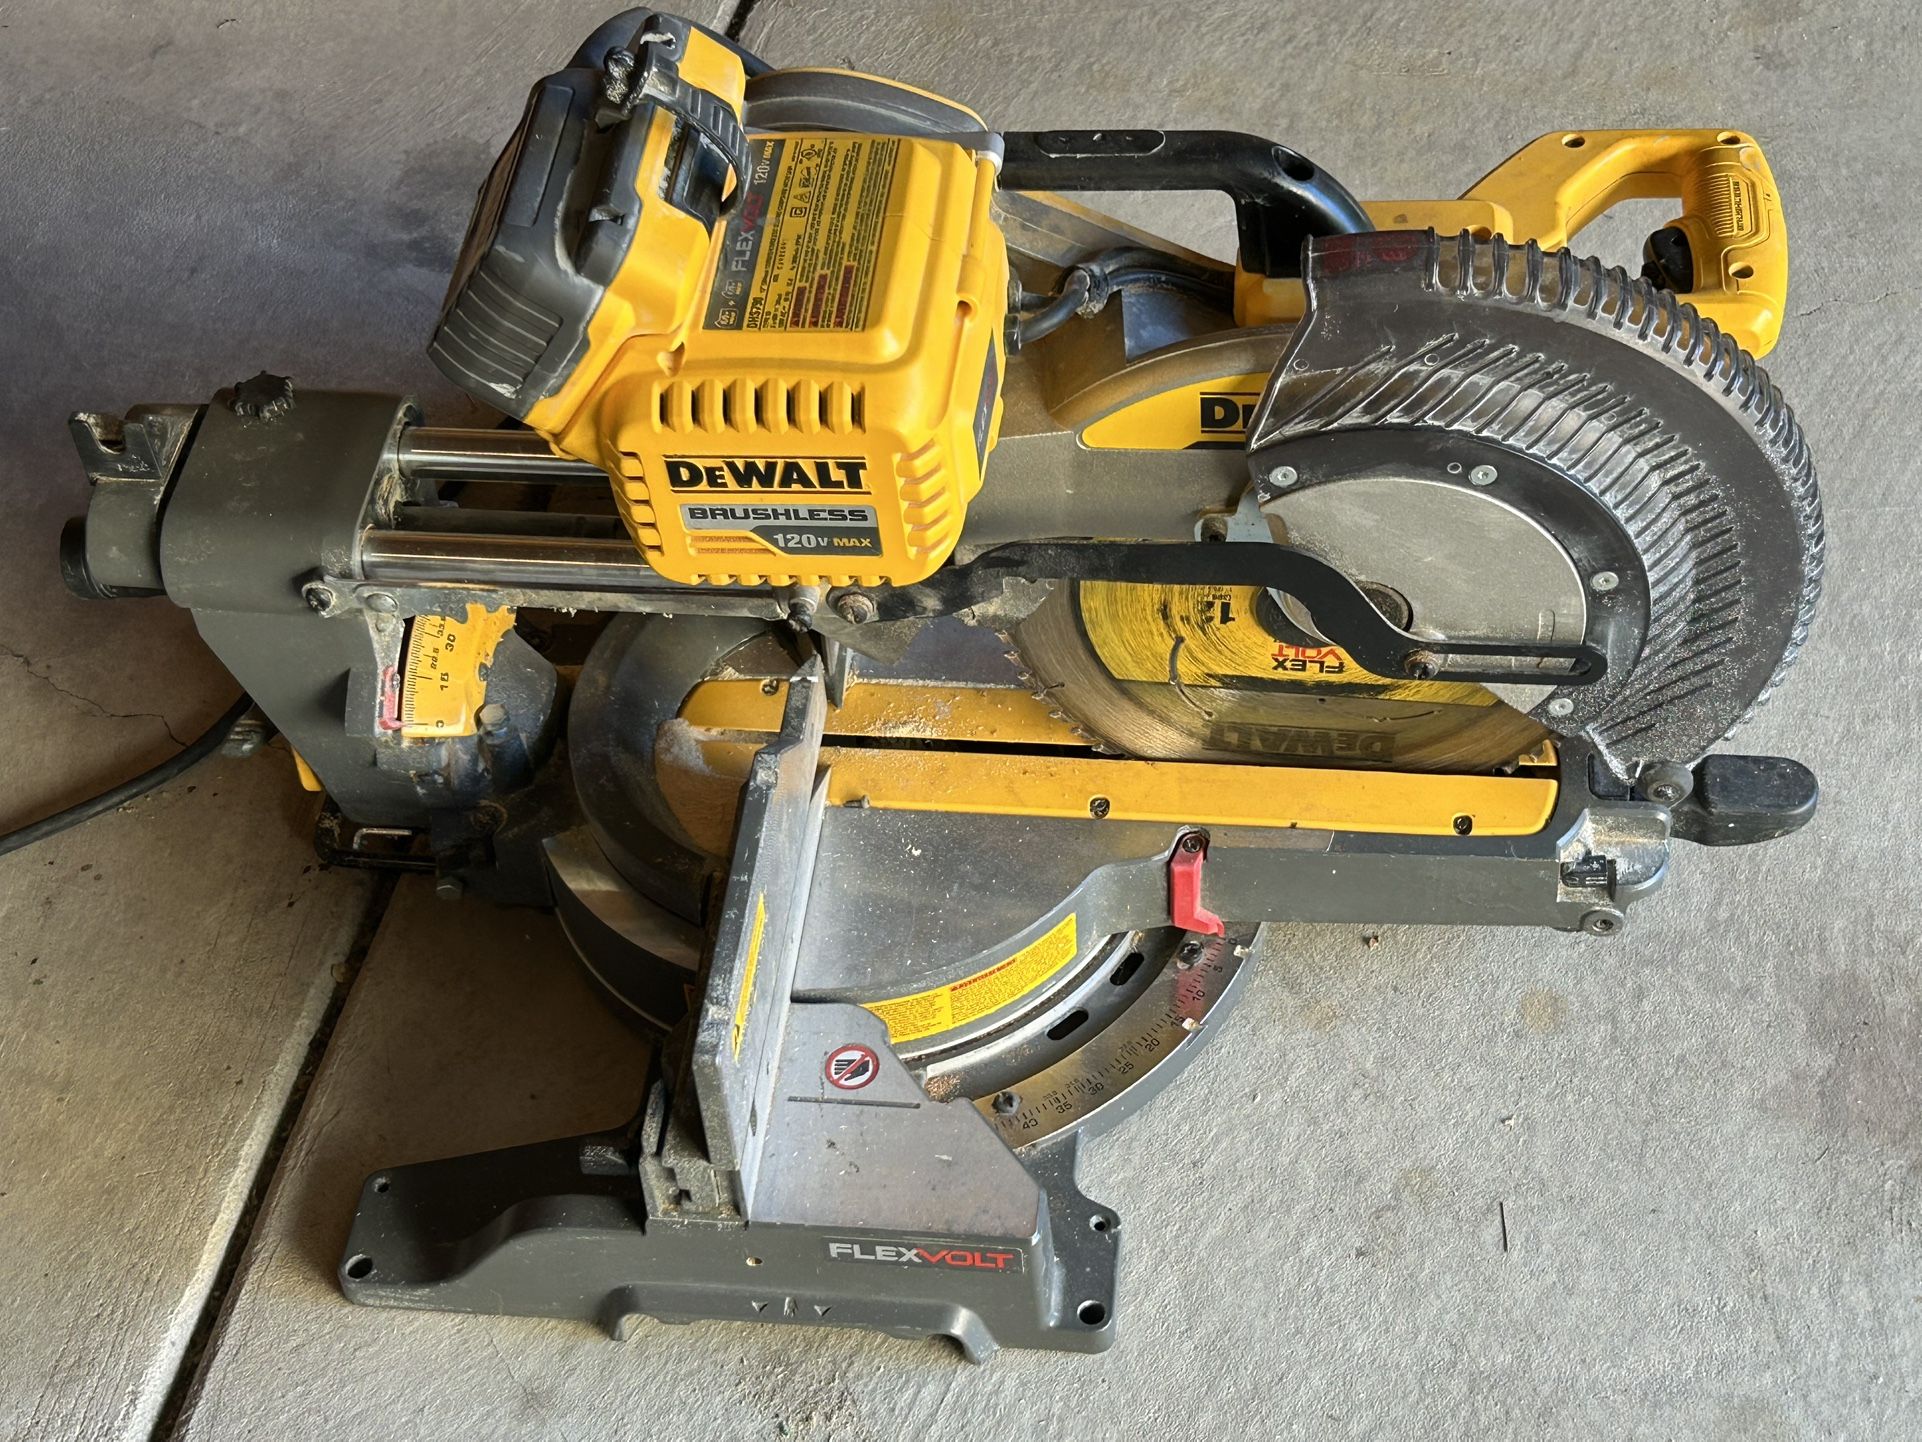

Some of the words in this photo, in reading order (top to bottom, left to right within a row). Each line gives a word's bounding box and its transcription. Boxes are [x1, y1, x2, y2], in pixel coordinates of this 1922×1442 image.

[664, 460, 868, 490] DEWALT
[688, 507, 869, 522] BRUSHLESS
[773, 533, 828, 549] 120V
[833, 537, 872, 549] MAX
[445, 633, 457, 652] 30
[1272, 658, 1348, 674] FLEX
[1144, 1038, 1160, 1052] 20
[1118, 1062, 1135, 1075] 25
[1088, 1082, 1105, 1096] 30
[1055, 1102, 1073, 1114] 35
[829, 1242, 1014, 1270] FLEXVOLT
